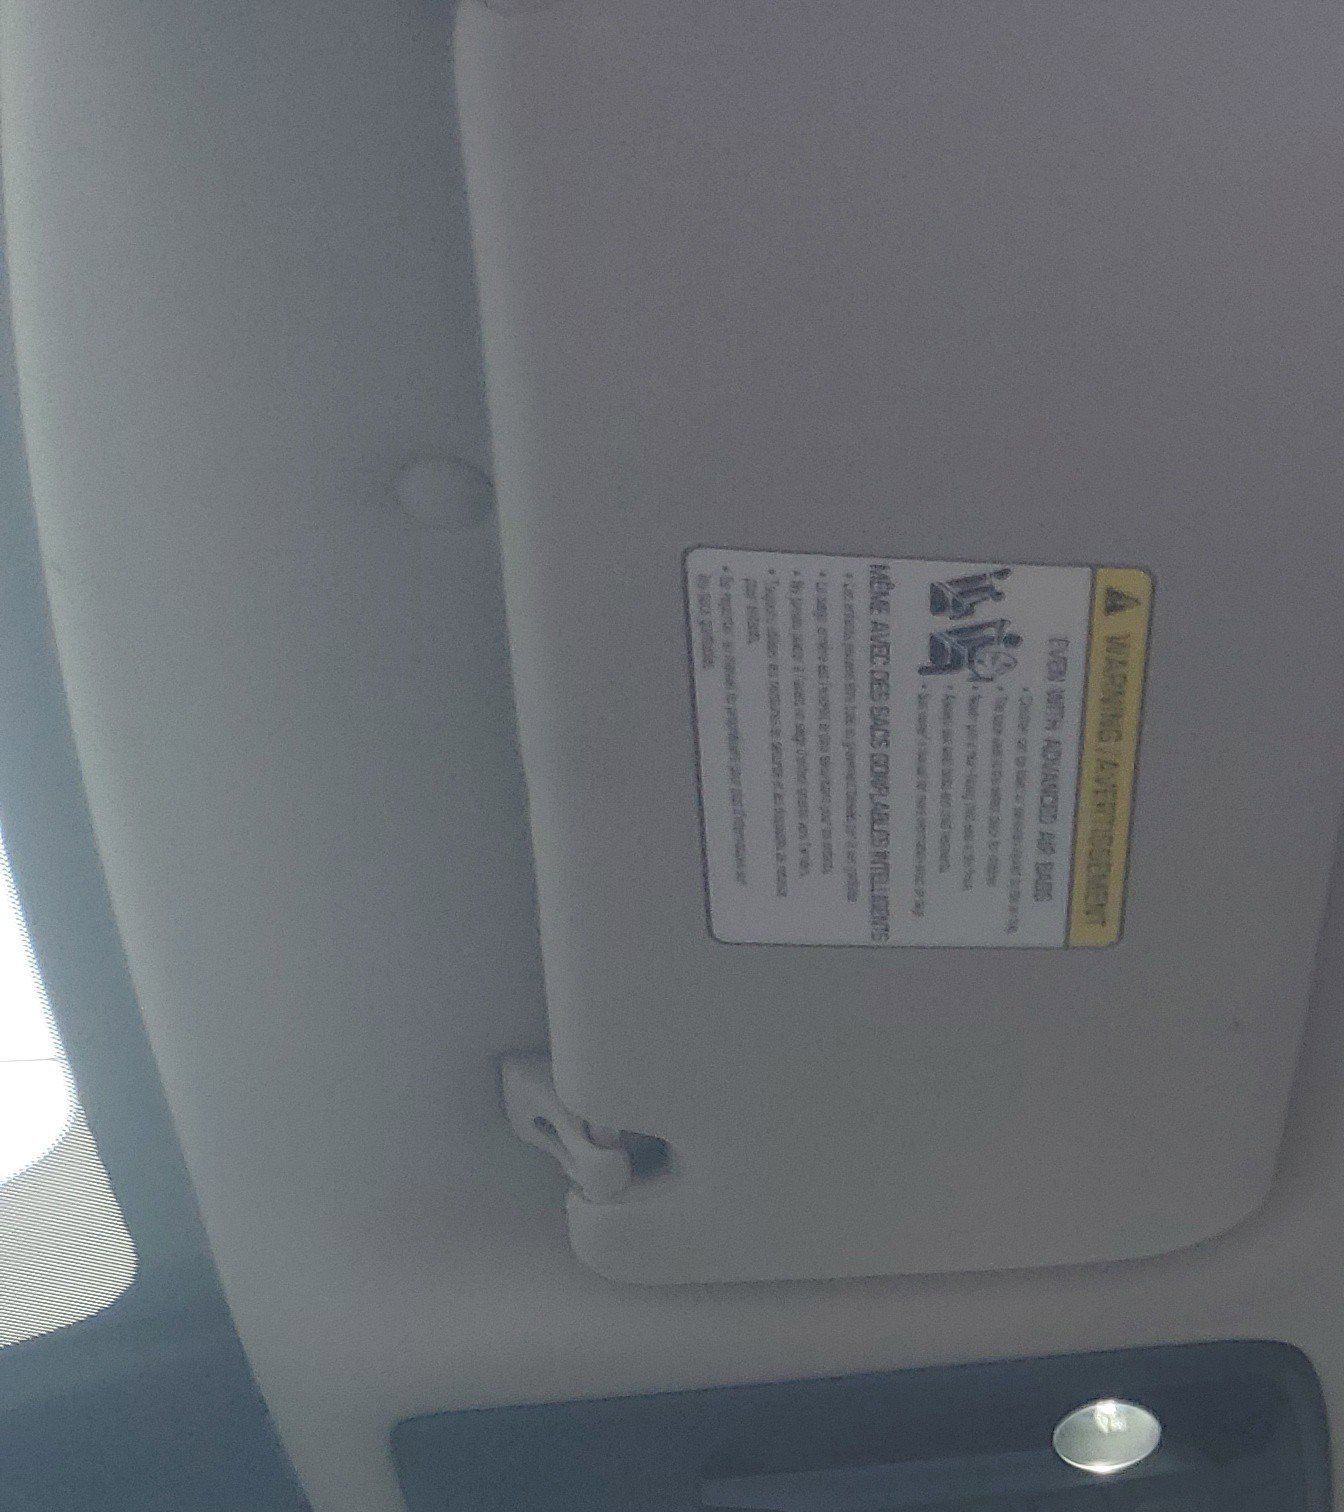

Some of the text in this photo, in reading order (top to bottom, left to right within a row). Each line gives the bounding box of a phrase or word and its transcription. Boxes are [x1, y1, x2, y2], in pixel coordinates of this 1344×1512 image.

[869, 620, 891, 666] AVEC
[1046, 637, 1069, 681] EVEN
[869, 669, 890, 702] DES
[869, 706, 890, 748] SACS
[1043, 688, 1066, 731] WITH
[1037, 738, 1063, 823] ADVANCED
